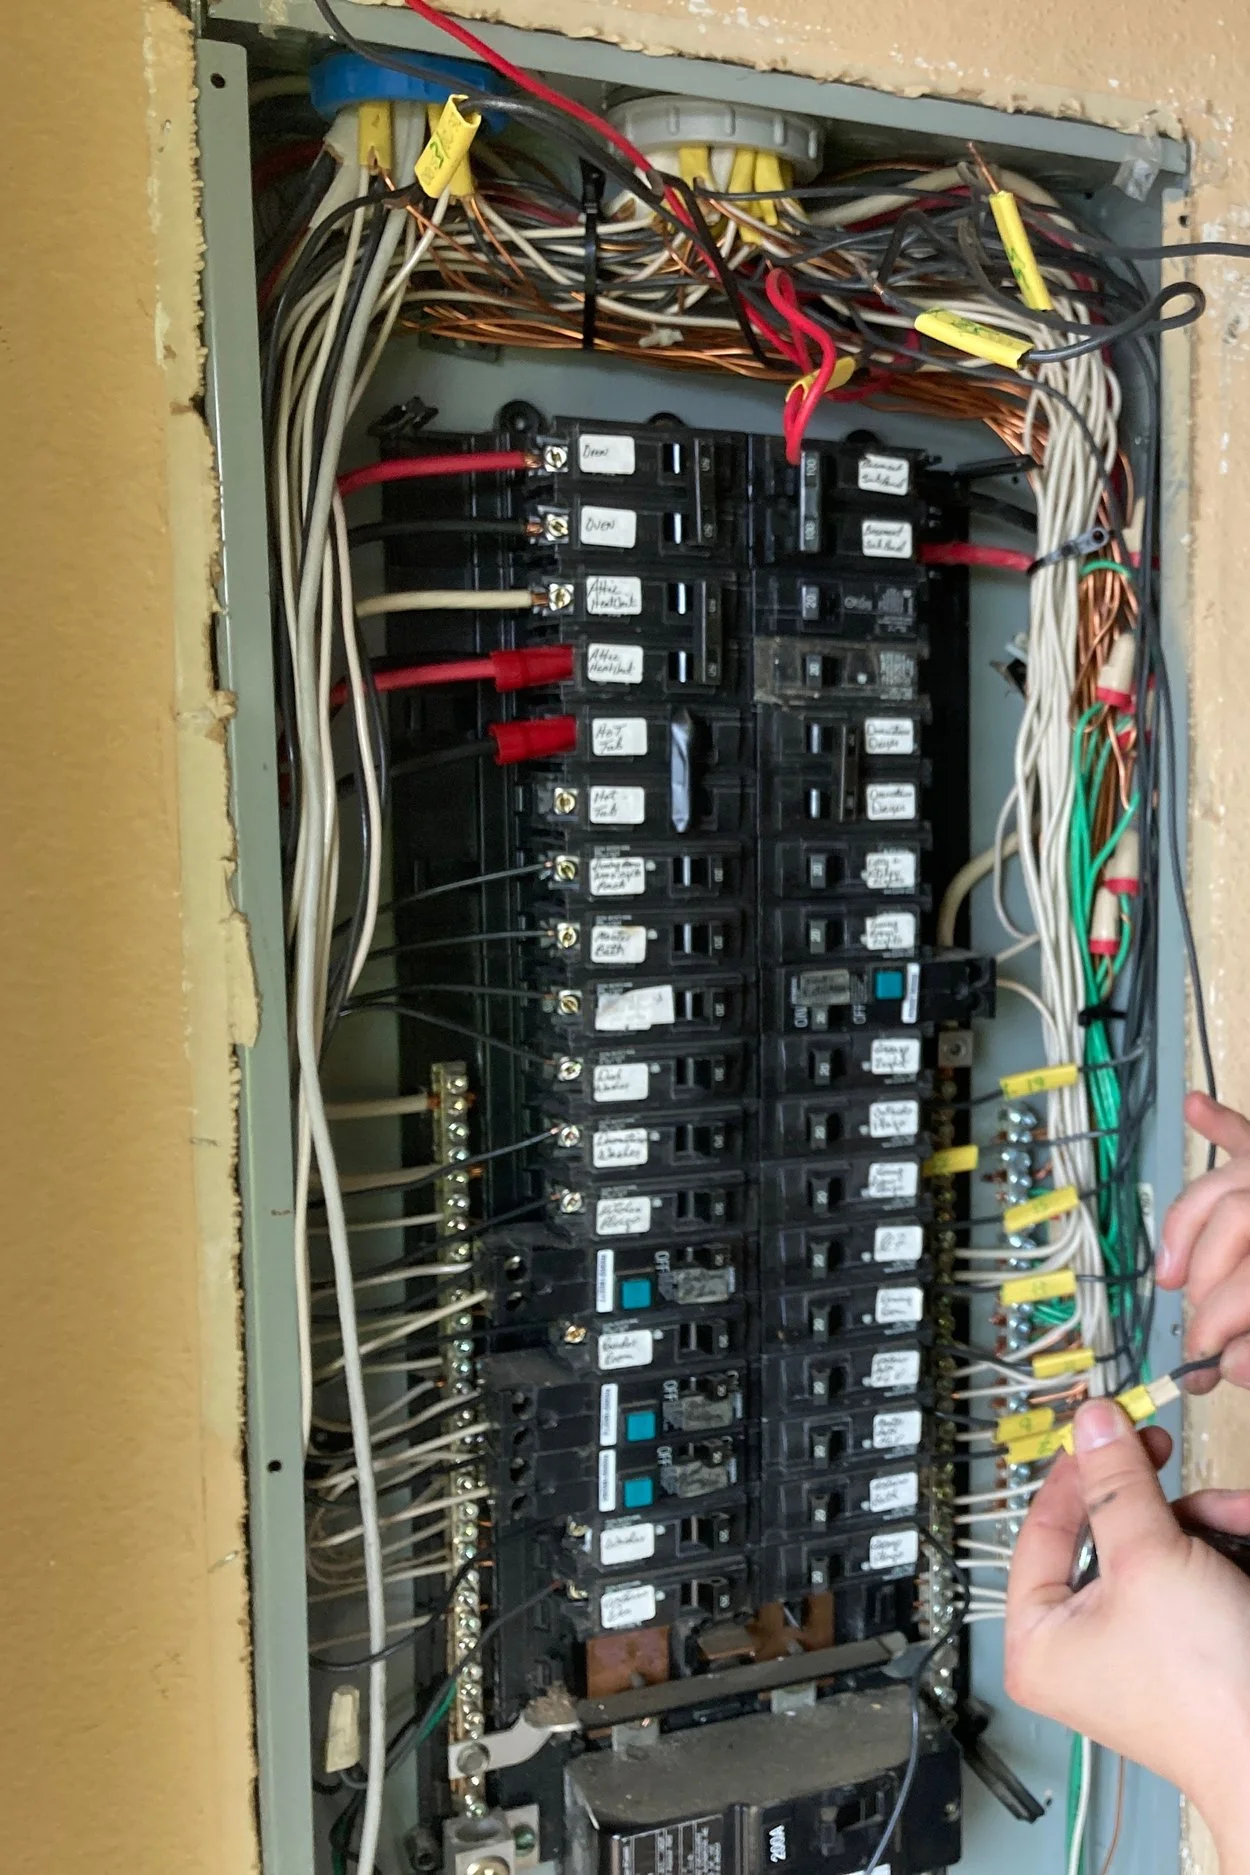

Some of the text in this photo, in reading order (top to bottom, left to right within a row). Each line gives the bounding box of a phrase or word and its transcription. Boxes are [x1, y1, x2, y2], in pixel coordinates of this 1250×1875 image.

[806, 458, 817, 476] 100
[805, 520, 816, 540] 100
[806, 593, 817, 608] 20
[809, 662, 820, 676] 20
[794, 1006, 808, 1028] ON
[853, 1004, 866, 1024] OFF
[769, 1824, 787, 1863] 200A
